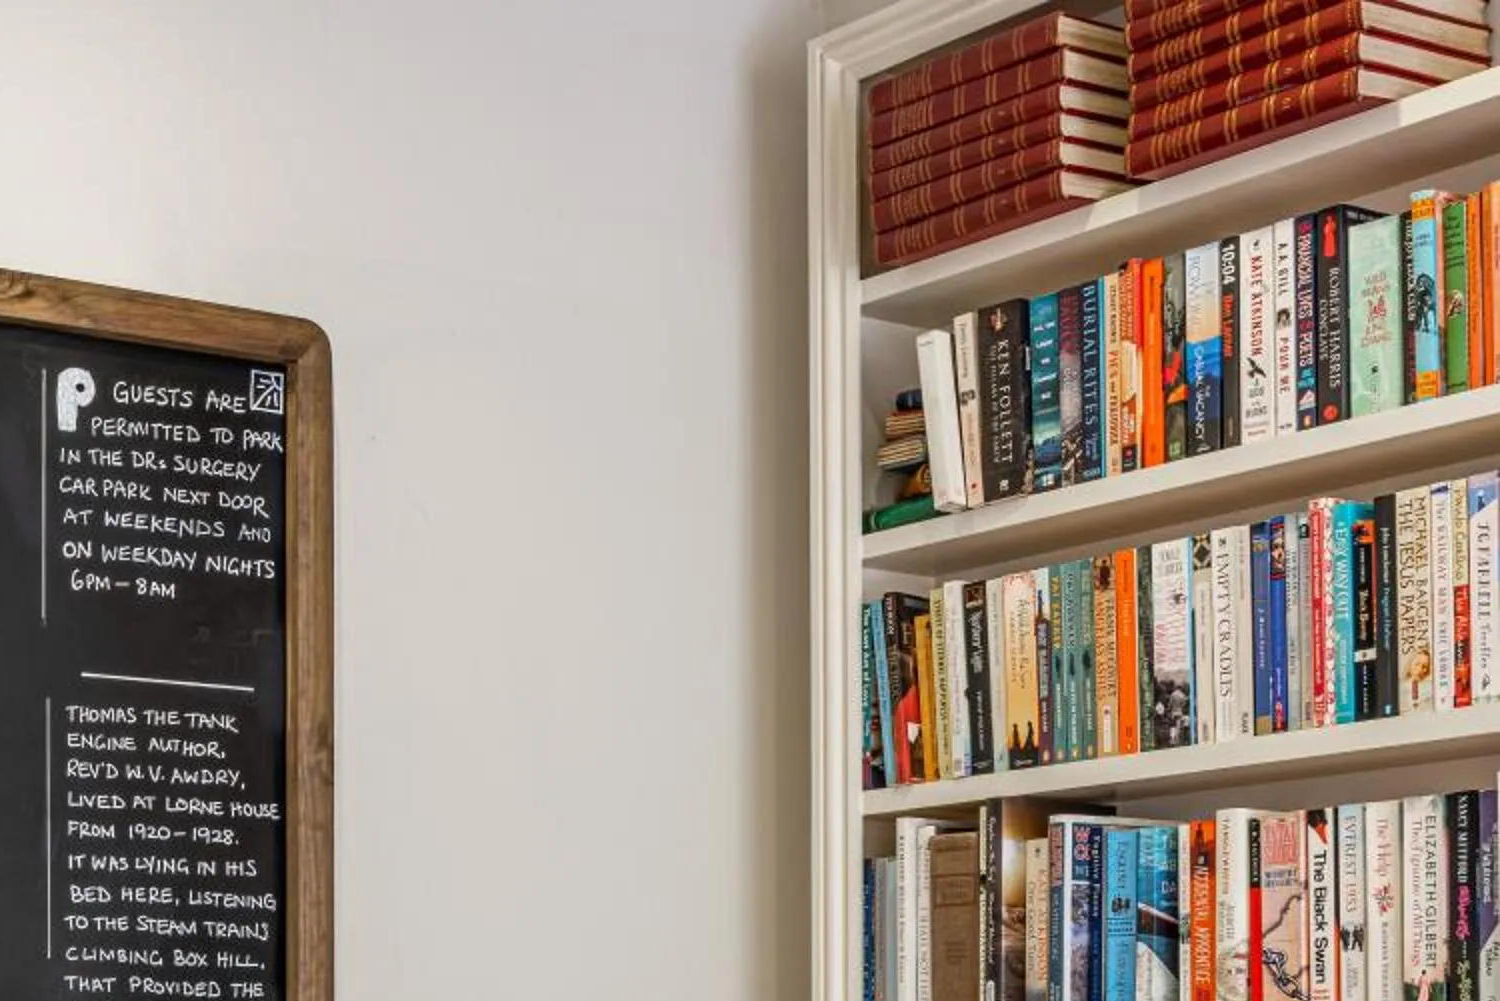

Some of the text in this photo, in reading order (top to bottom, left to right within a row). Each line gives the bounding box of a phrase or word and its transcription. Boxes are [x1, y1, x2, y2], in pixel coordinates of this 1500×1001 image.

[1222, 244, 1235, 284] 10:04
[1251, 255, 1264, 358] KATE ATKINSON
[1083, 284, 1099, 425] BURIAL RITES
[1330, 331, 1341, 389] HARRIS
[55, 367, 96, 432] P
[113, 381, 246, 414] GUESTS ARE
[997, 339, 1013, 463] KEN FOLLETT
[91, 416, 282, 452] PERMITTED TO PARK
[59, 475, 270, 519] CAR PARK NEXT DOOR
[62, 541, 275, 579] ON WEEKDAY NIGHTS
[1399, 500, 1416, 655] THE JESUS PAPERS
[1415, 497, 1429, 651] MICHAEL BAIGENT
[1216, 552, 1232, 697] EMPTY CRADLES
[67, 733, 226, 759] ENGINE AUTHOR,
[68, 791, 280, 820] LIVED AT LORNE HOUSE
[1373, 843, 1393, 877] Help
[1313, 850, 1328, 984] The Black Swan
[1425, 815, 1437, 968] ELIZABETH GILBERT
